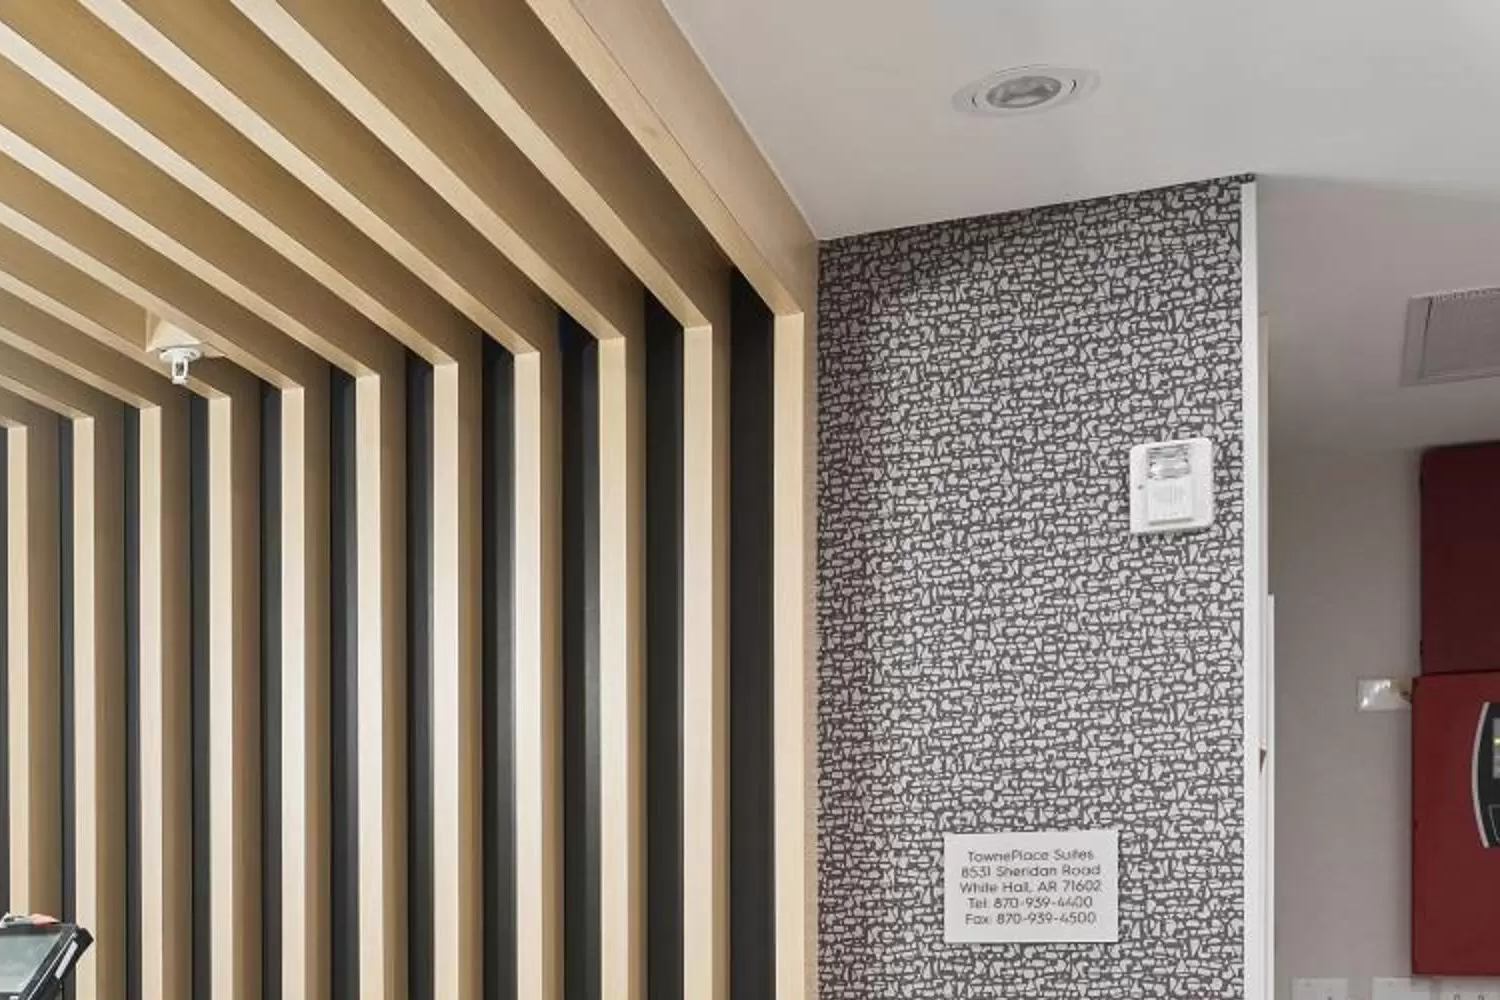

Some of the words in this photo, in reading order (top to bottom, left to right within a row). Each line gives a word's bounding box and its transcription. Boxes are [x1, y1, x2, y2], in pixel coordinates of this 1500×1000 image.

[968, 849, 1049, 863] TownePlace
[1053, 848, 1095, 861] Suites
[961, 866, 991, 878] 8531
[996, 865, 1057, 878] Sheridan
[1061, 863, 1101, 876] Road
[959, 881, 998, 894] White
[1037, 881, 1058, 893] AR
[1062, 880, 1102, 893] 71602
[993, 895, 1094, 909] 870-939-4400
[996, 911, 1097, 925] 870-939-4500
